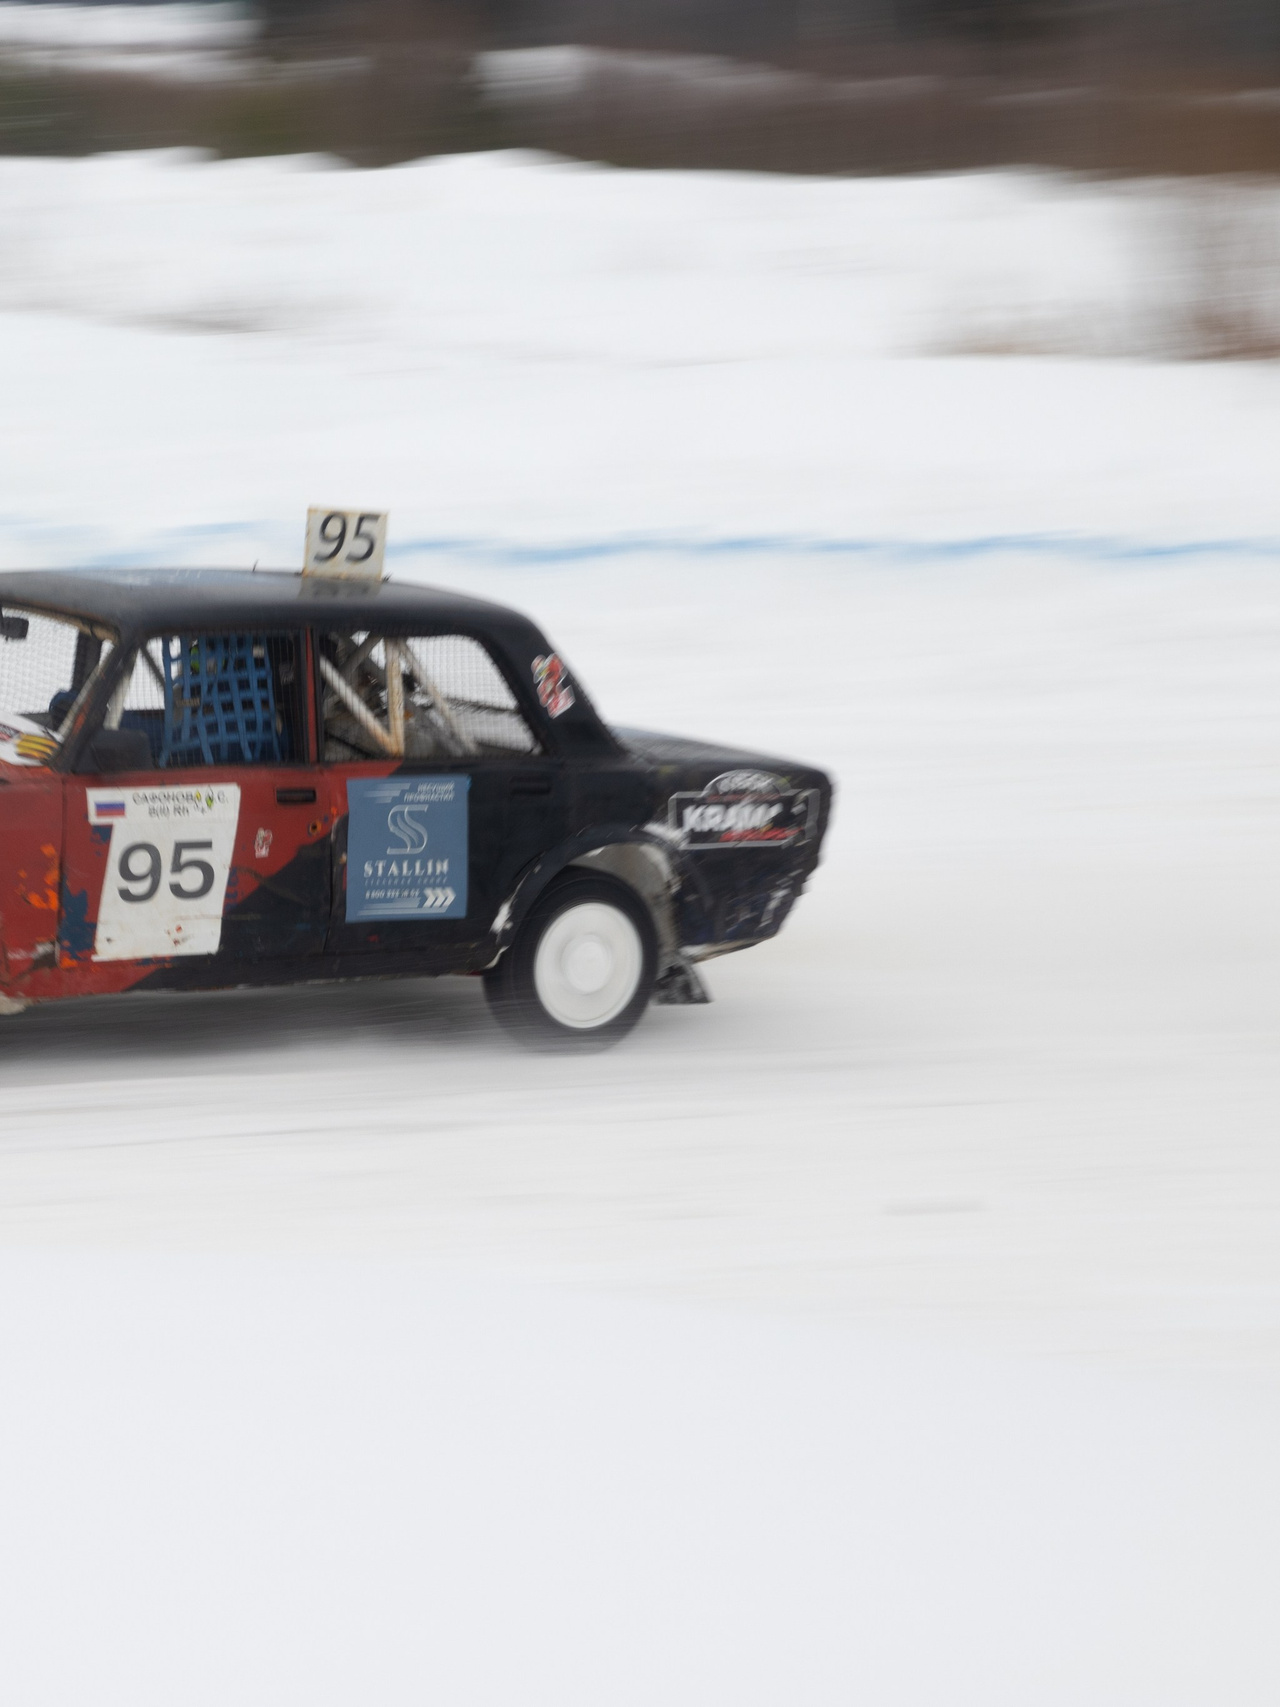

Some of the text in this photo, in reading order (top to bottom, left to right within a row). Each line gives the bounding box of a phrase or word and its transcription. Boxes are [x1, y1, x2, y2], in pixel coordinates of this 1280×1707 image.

[313, 512, 380, 563] 95
[118, 841, 215, 903] 95
[363, 859, 449, 877] STALLIN
